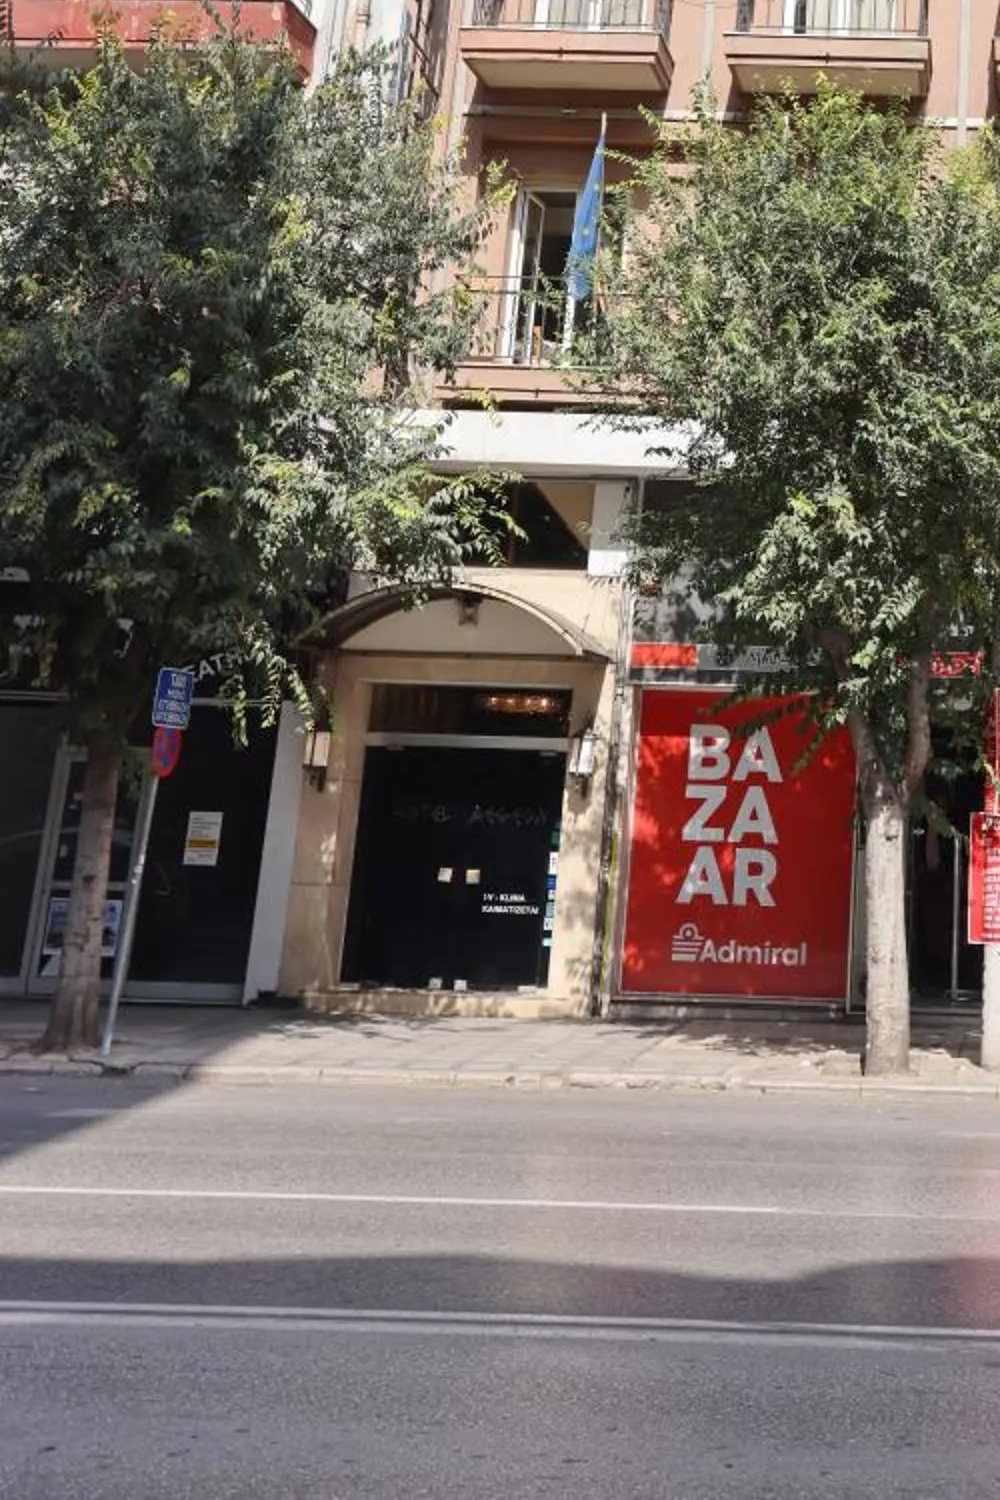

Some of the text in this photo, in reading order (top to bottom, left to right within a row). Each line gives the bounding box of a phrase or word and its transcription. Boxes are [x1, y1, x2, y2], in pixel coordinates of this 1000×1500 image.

[687, 723, 784, 783] BA
[681, 784, 779, 844] ZA
[676, 845, 777, 907] AR
[700, 939, 808, 968] Admiral
